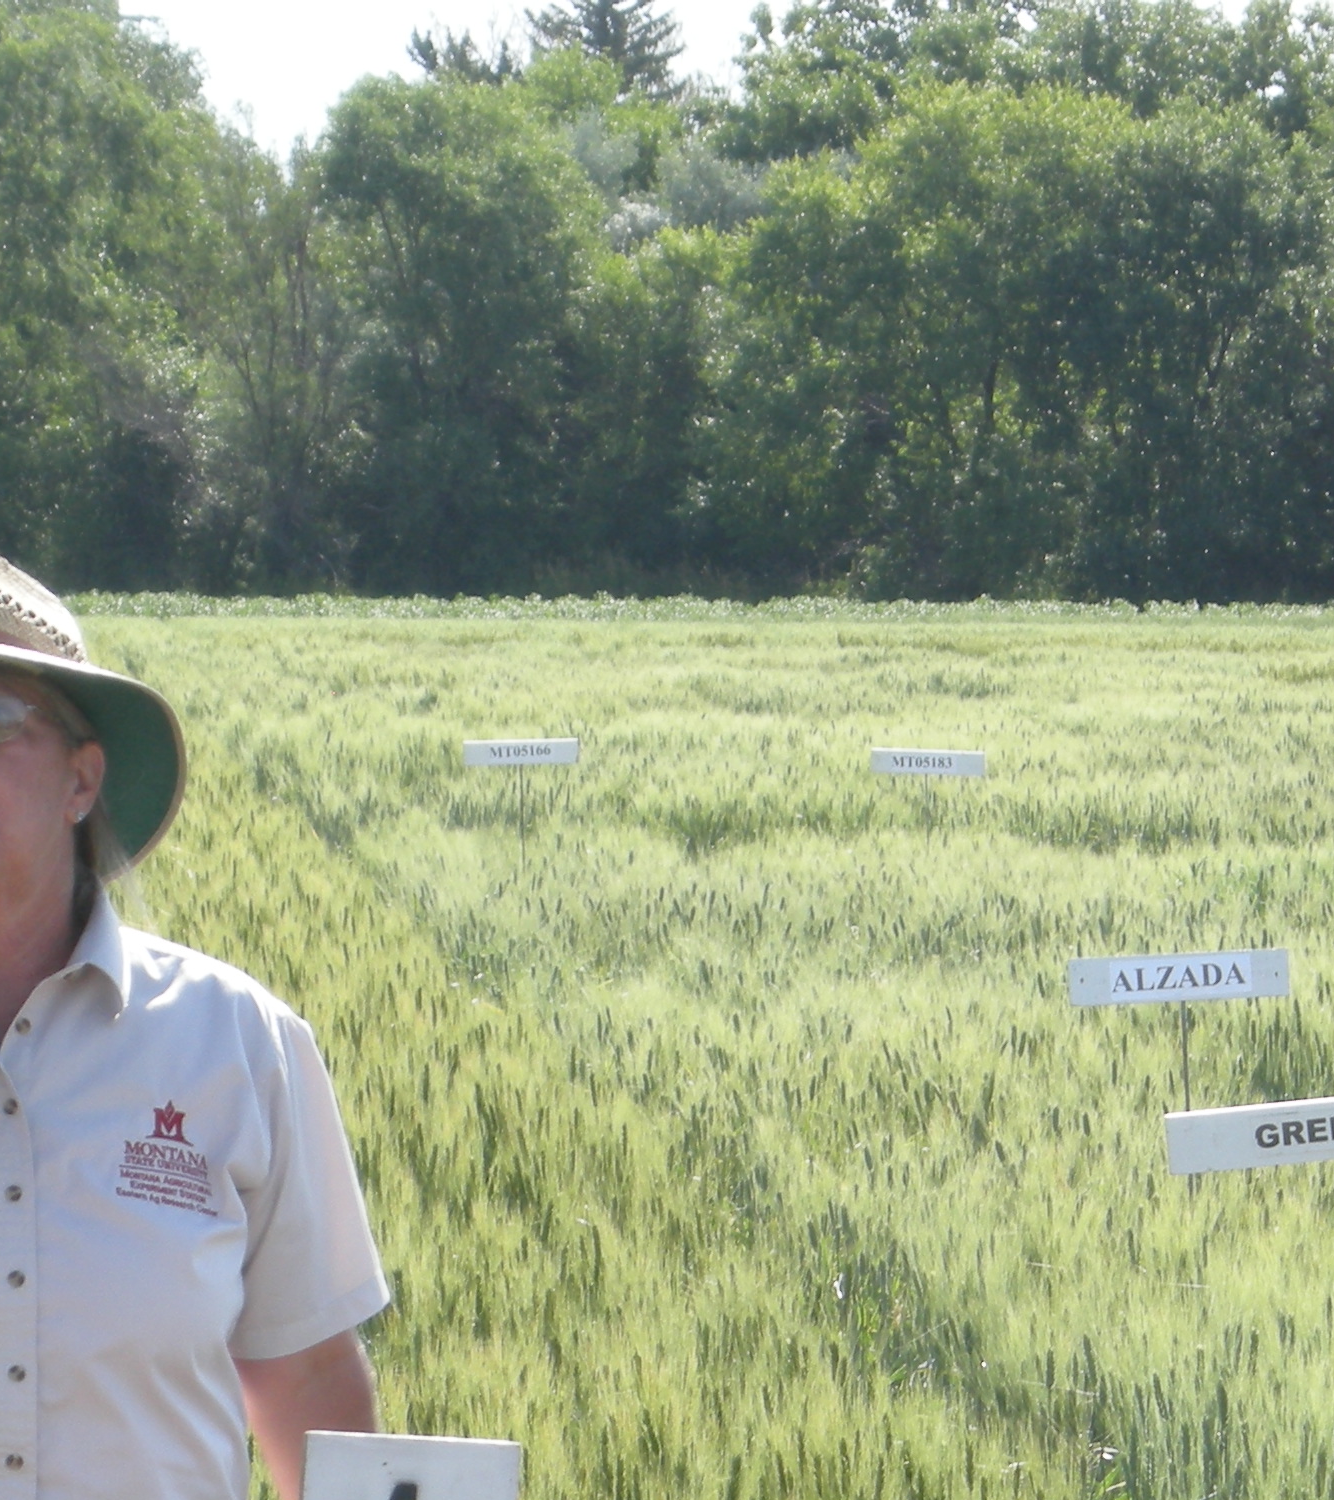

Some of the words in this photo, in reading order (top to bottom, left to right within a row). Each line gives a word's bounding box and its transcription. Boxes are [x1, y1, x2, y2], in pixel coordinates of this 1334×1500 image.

[490, 745, 551, 758] MT05166
[892, 756, 952, 768] MT05183
[1112, 962, 1246, 993] ALZADA
[124, 1140, 207, 1170] MONTANA
